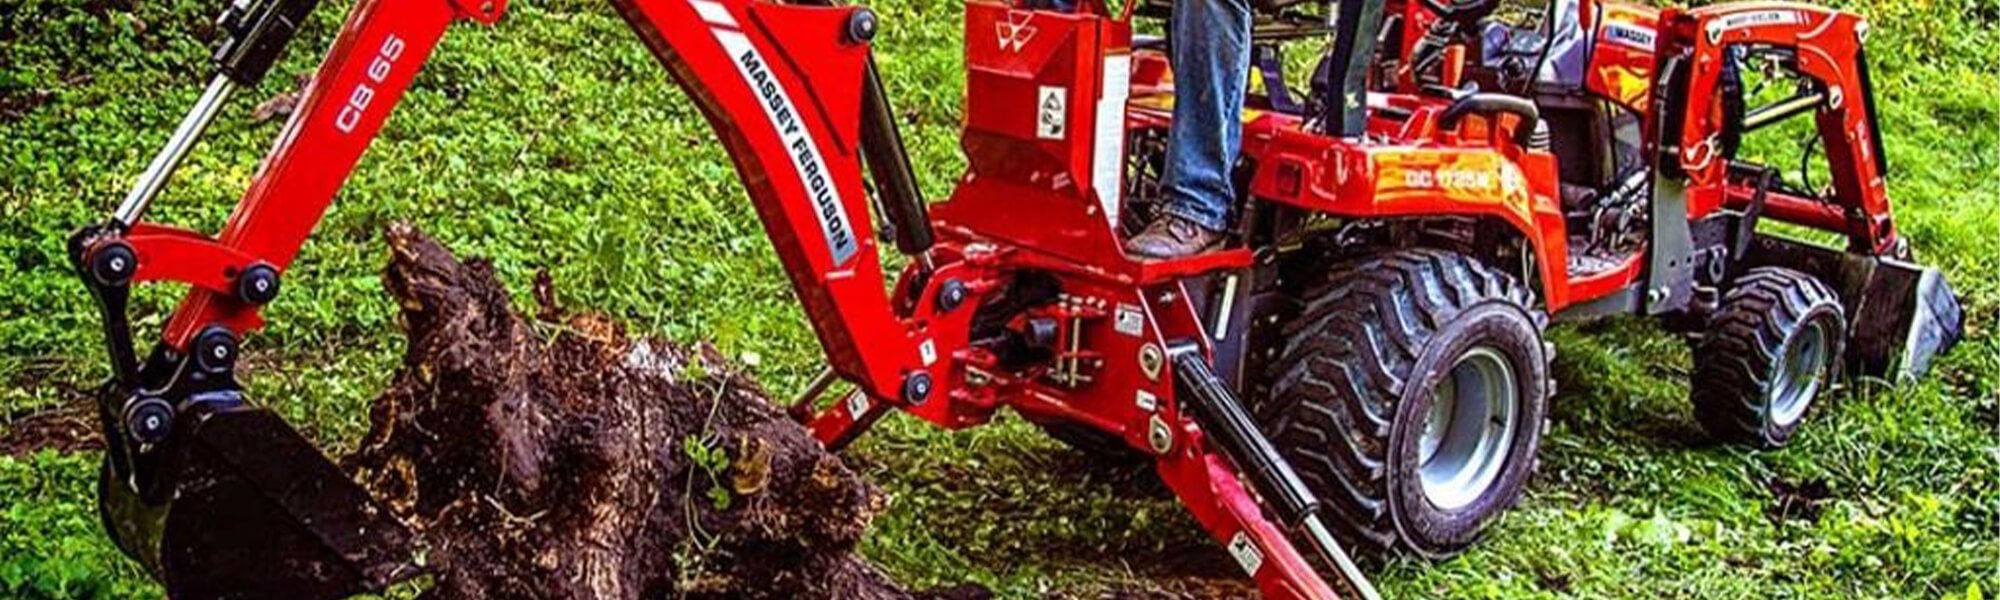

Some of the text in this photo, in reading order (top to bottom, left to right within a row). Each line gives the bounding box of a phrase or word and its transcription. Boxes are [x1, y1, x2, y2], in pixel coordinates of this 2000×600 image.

[335, 33, 406, 133] CB 65
[740, 50, 849, 250] MASSEY FERGUSON
